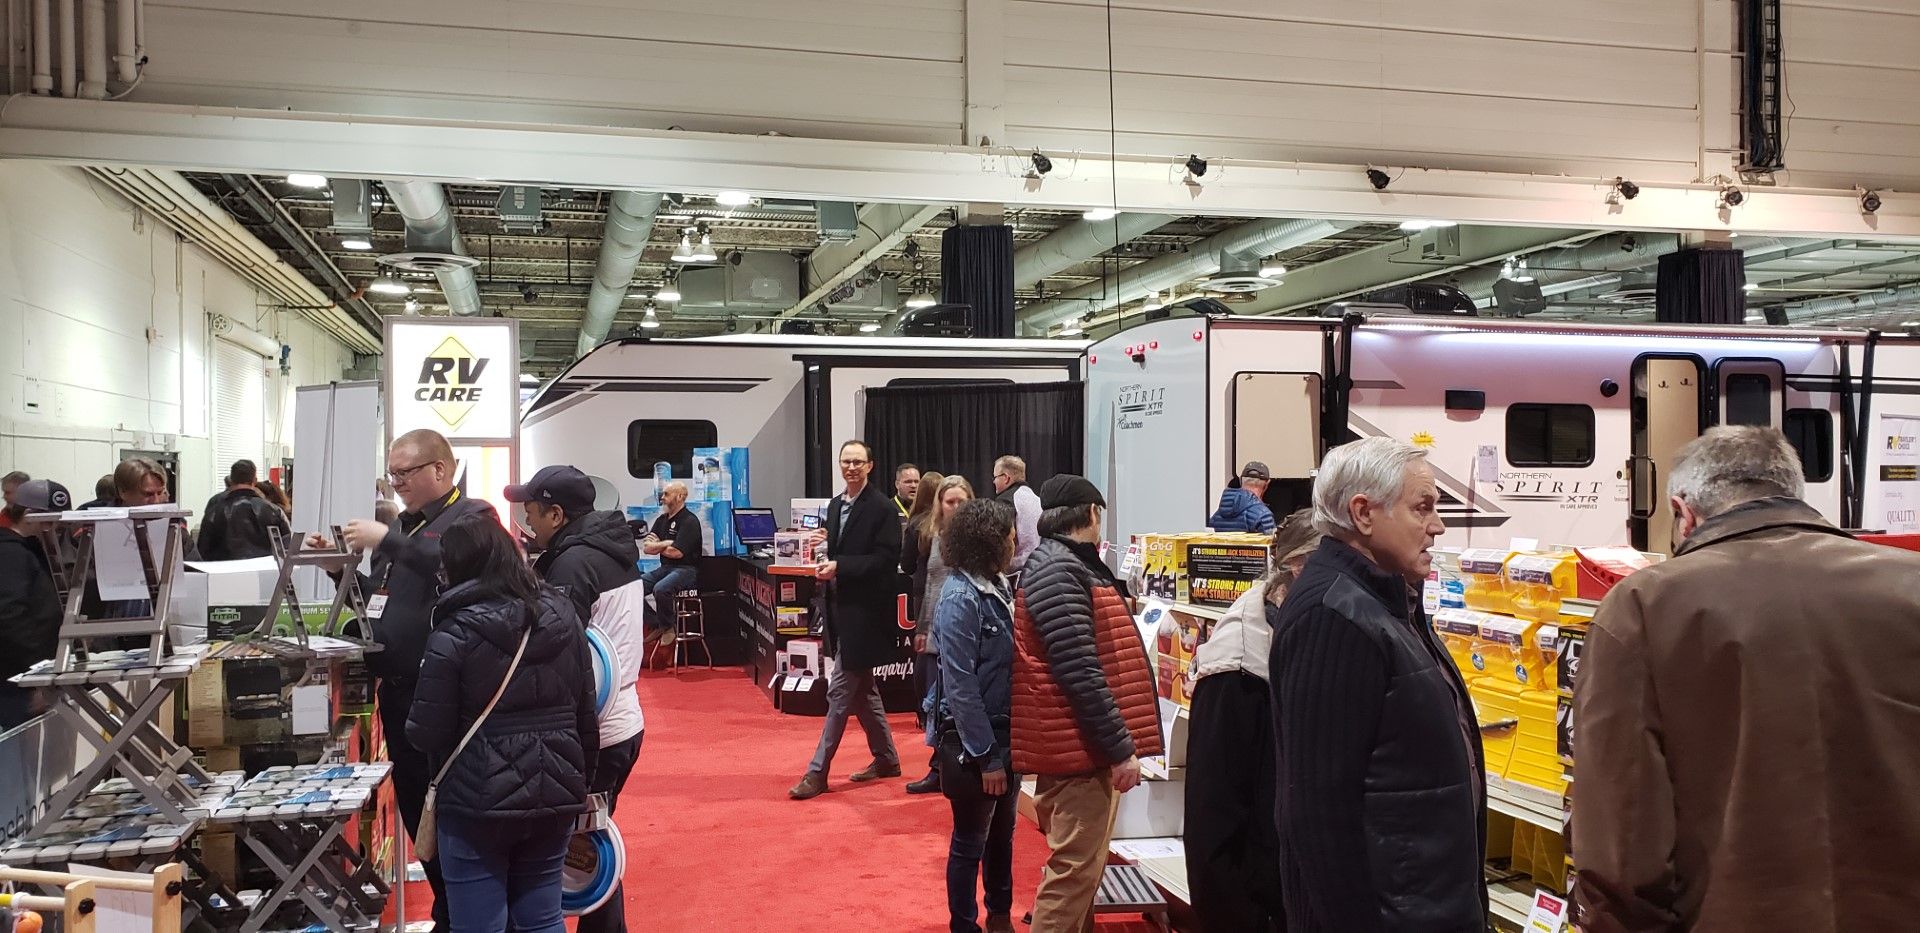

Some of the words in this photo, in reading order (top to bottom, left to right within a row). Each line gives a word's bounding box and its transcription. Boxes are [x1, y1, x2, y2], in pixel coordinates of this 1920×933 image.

[418, 357, 490, 384] RV
[414, 387, 483, 402] CARE
[1118, 387, 1166, 405] SPIRIT
[1147, 401, 1164, 411] XTR
[1494, 481, 1602, 494] SPIRIT
[1566, 495, 1599, 503] XTR
[1886, 510, 1916, 523] QUALITY
[1207, 579, 1234, 590] STRONG
[1192, 587, 1209, 598] JACK
[1209, 589, 1242, 600] STABILIZE
